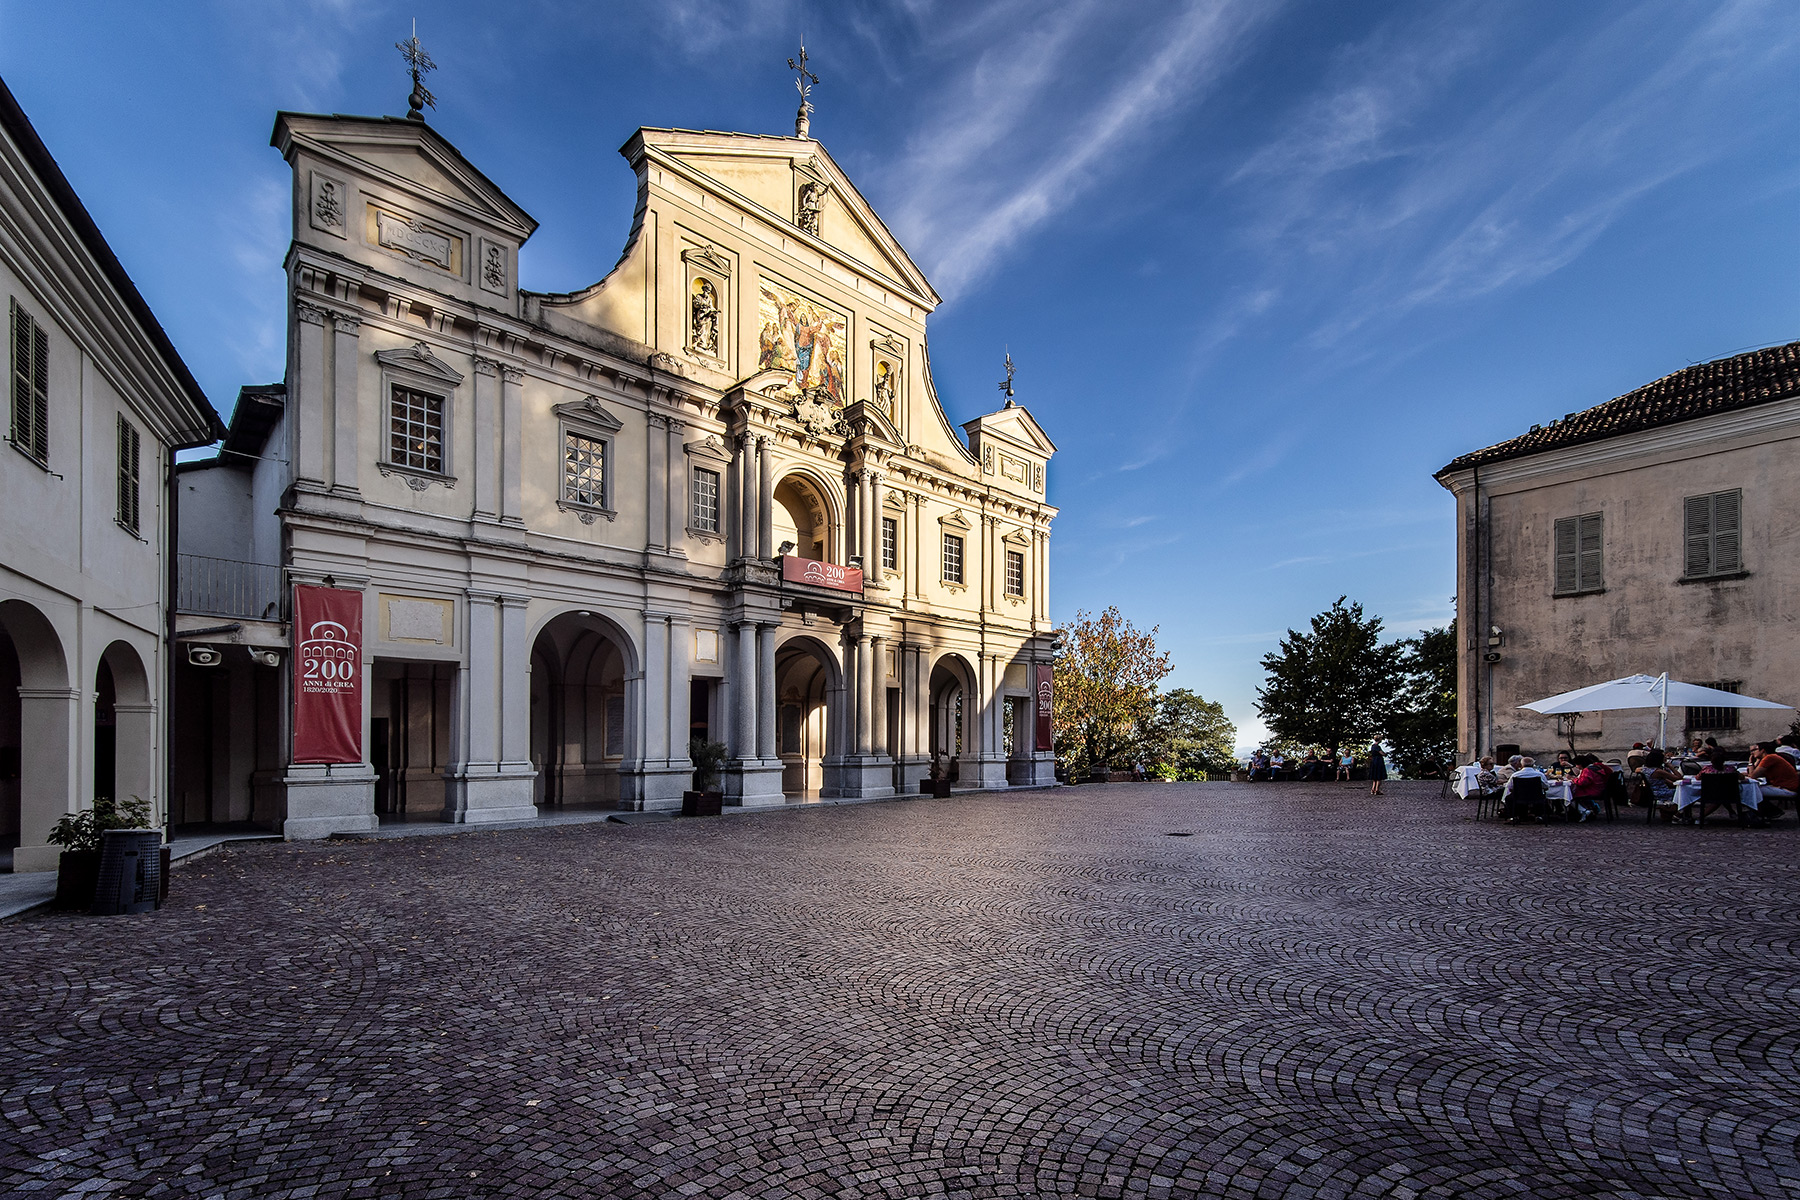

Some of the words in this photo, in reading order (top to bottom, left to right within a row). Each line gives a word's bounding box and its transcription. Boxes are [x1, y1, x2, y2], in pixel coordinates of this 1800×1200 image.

[826, 565, 845, 580] 200
[303, 658, 354, 681] 200
[333, 681, 354, 689] CREA
[1039, 699, 1052, 710] 200
